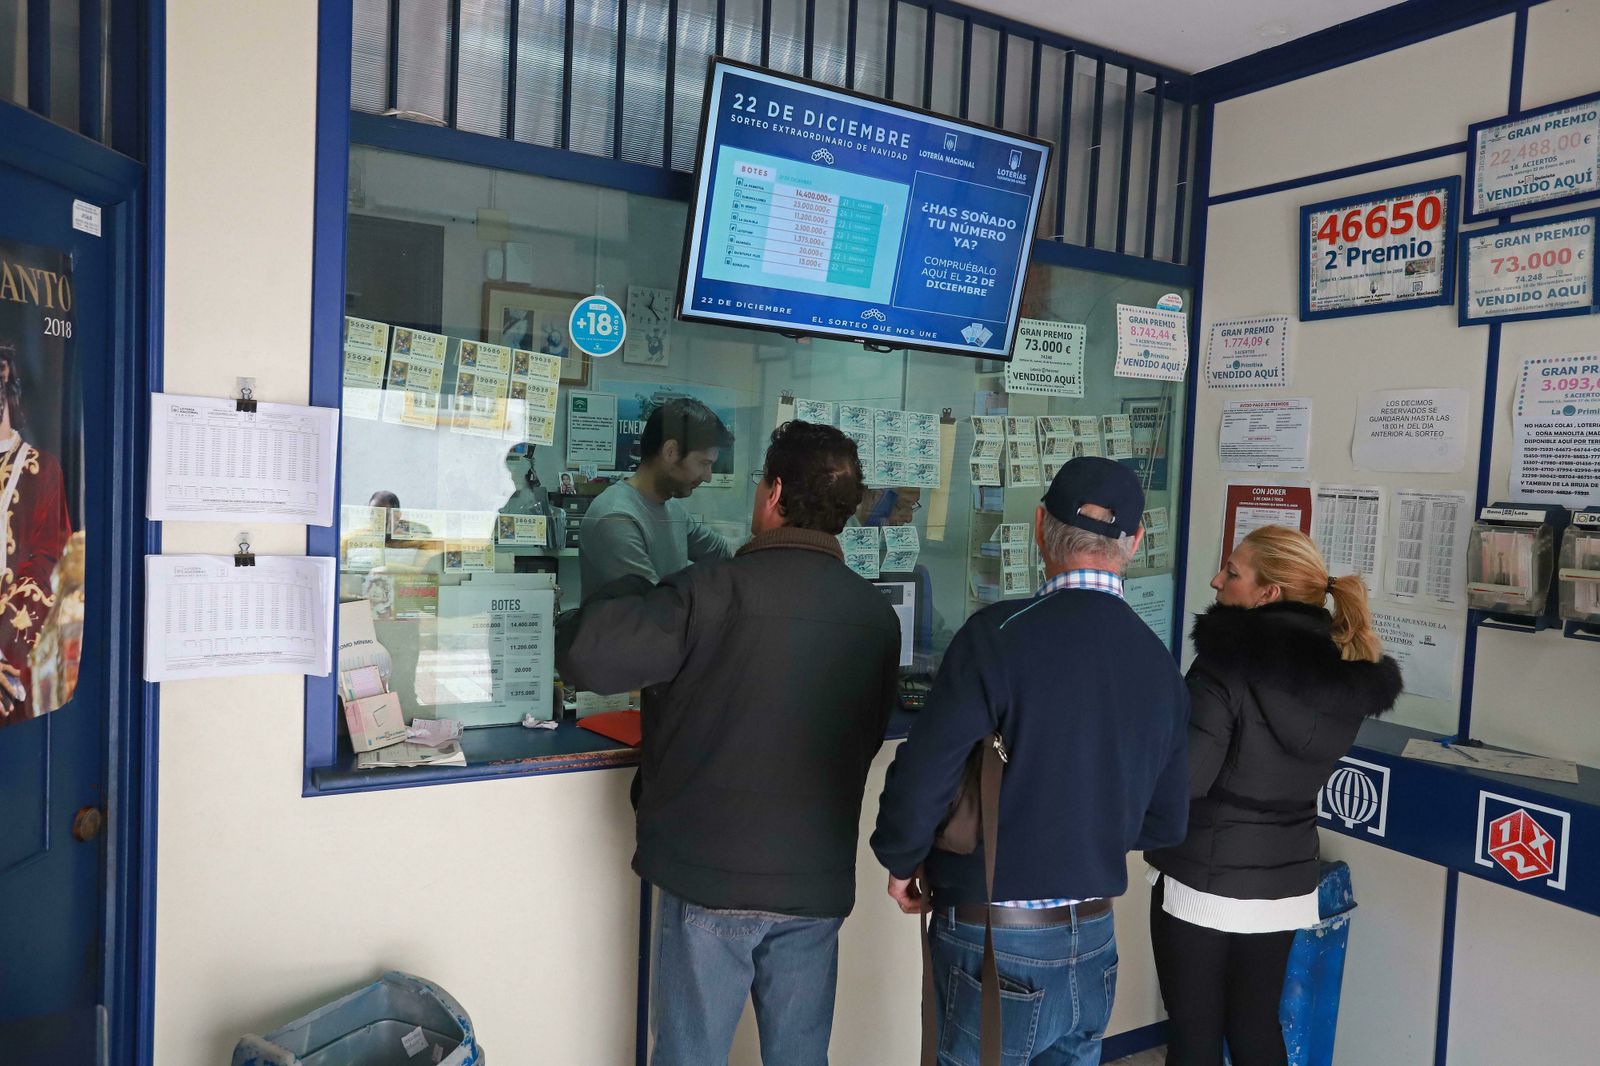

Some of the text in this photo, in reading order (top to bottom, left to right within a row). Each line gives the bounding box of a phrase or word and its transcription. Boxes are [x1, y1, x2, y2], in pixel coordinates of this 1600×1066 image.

[733, 93, 911, 149] 22 DE DICIEMBRE
[1507, 111, 1597, 140] GRAN PREMIO
[730, 114, 908, 161] SORTEO EXTRAORDINARIO DE NAVIDAD
[919, 149, 975, 169] LOTERÍA NACIONAL
[1489, 132, 1591, 167] 22.488,00 €
[741, 166, 769, 177] BOTES
[1522, 156, 1558, 168] ACIERTOS
[997, 168, 1027, 180] LOTERÍAS
[1487, 181, 1550, 202] VENDIDO
[1554, 168, 1593, 189] AQUÍ
[922, 202, 1016, 230] ¿HAS SOÑADO
[1317, 195, 1441, 245] 46650
[928, 217, 1006, 242] TU NÚMERO
[1494, 224, 1591, 248] GRAN PREMIO
[953, 237, 978, 250] YA?
[1346, 237, 1432, 267] Premio
[924, 254, 997, 276] COMPRUÉBALO
[1490, 247, 1586, 274] 73.000 €
[0, 260, 72, 312] ANTO
[921, 266, 995, 287] AQUÍ EL 22 DE
[1515, 273, 1543, 283] 74.248
[926, 280, 988, 298] DICIEMBRE
[1476, 281, 1587, 307] VENDIDO AQUÍ
[701, 296, 793, 315] 22 DE DICIEMBRE
[44, 317, 72, 338] 2018
[577, 312, 613, 336] +18
[612, 314, 620, 336] AÑOS
[812, 316, 938, 339] EL SORTEO QUE NOS UNE
[1129, 315, 1176, 329] GRAN PREMIO
[1221, 325, 1275, 337] GRAN PREMIO
[1020, 328, 1073, 340] GRAN PREMIO
[1130, 325, 1177, 342] 8.742,44 €
[1224, 336, 1270, 349] 1.774,09 €
[1025, 338, 1072, 354] 73.000 €
[1123, 357, 1181, 372] VENDIDO AQUÍ
[1212, 367, 1279, 380] VENDIDO AQUÍ
[1541, 365, 1600, 377] GRAN PR
[1013, 372, 1076, 385] VENDIDO AQUÍ
[1369, 414, 1410, 422] GUARDARÁN
[1411, 414, 1434, 422] HASTA
[1266, 488, 1286, 496] JOKER
[492, 600, 521, 610] BOTES
[1498, 820, 1550, 860] 1 X
[1502, 851, 1539, 874] 2
